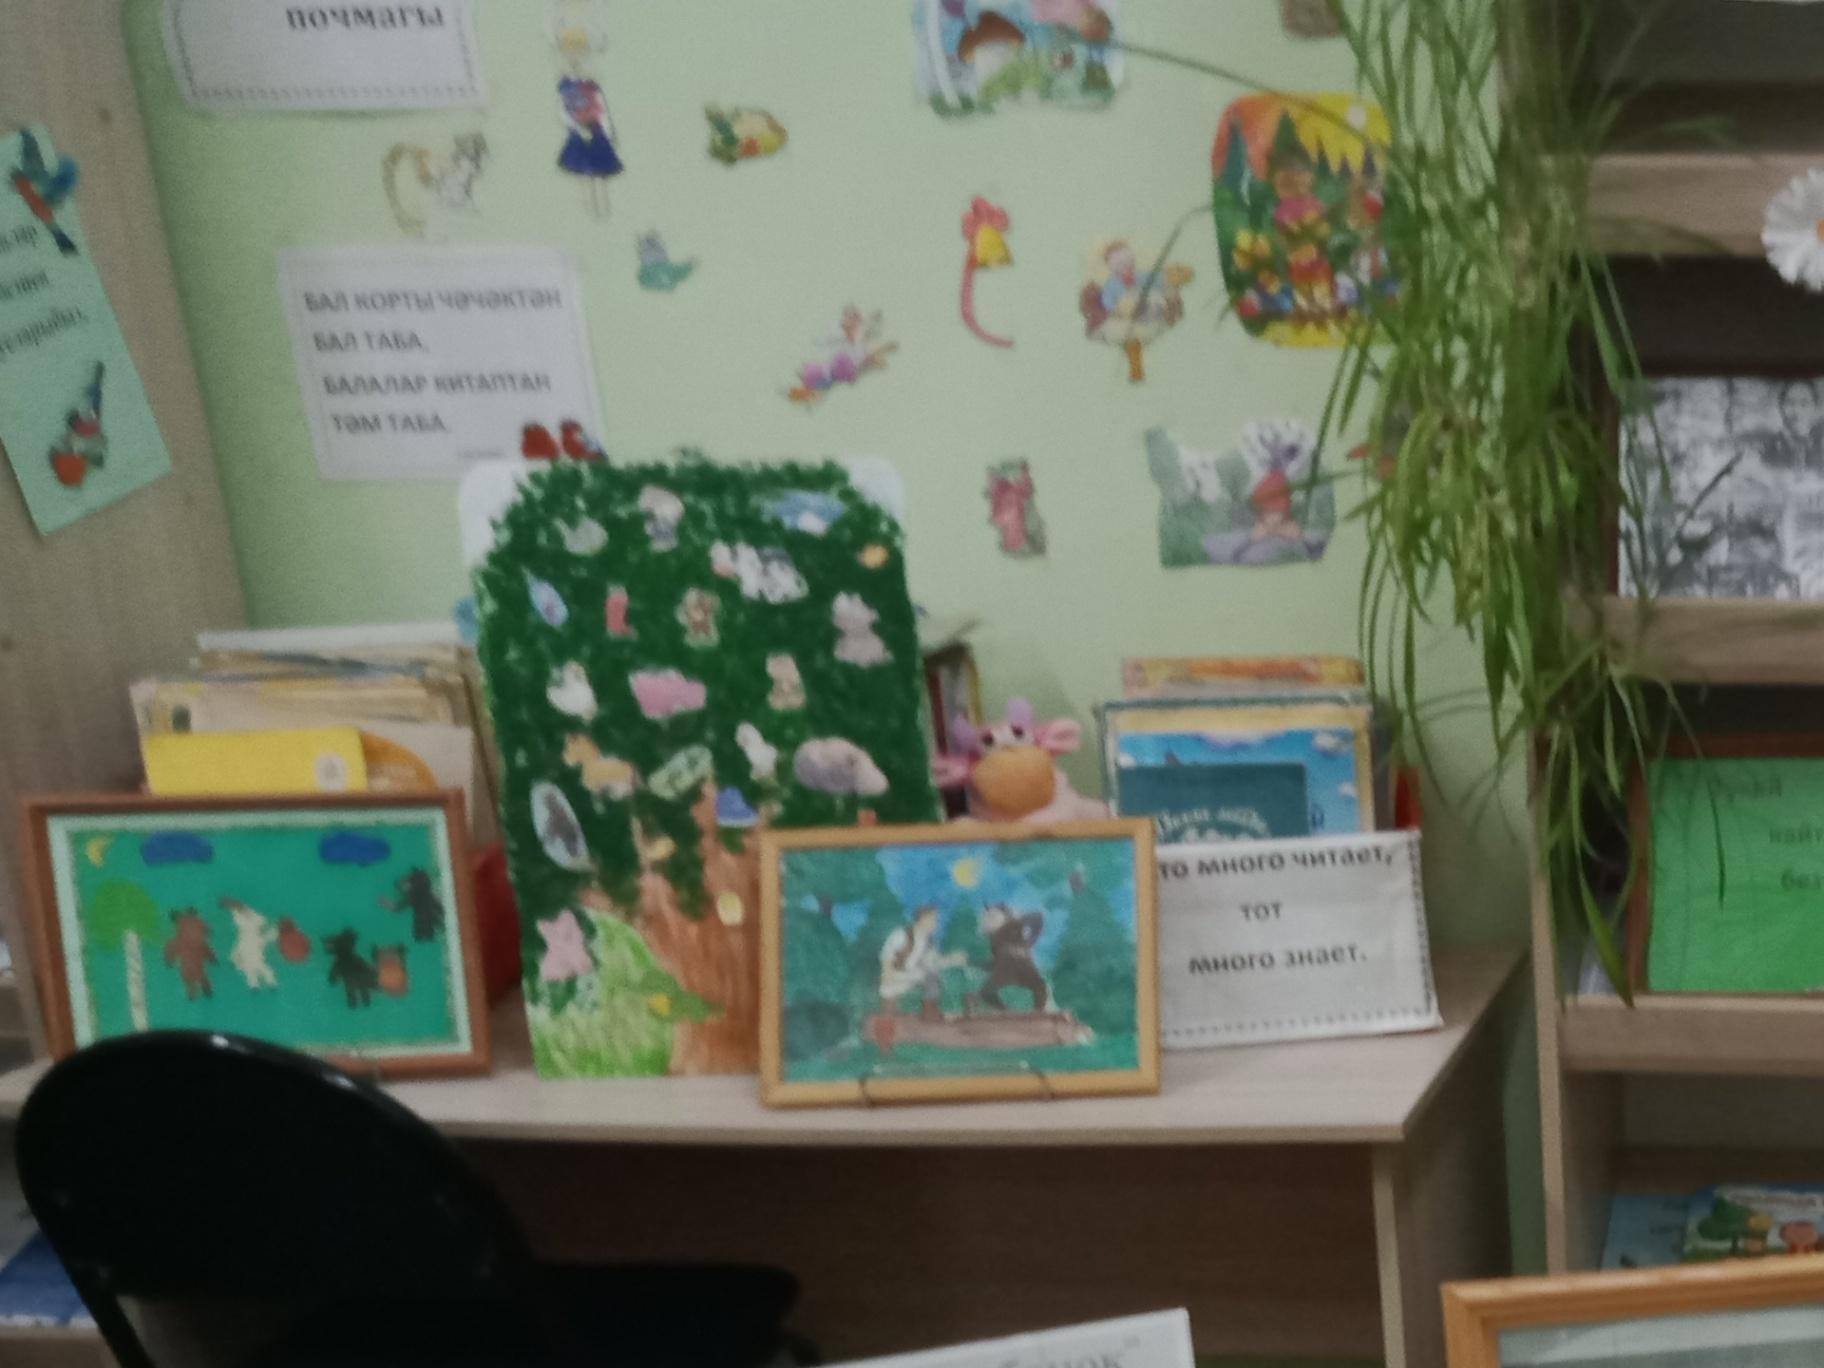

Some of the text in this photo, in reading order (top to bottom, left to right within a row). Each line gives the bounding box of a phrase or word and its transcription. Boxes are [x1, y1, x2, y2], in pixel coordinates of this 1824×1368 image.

[286, 7, 444, 29] почмагы
[304, 291, 349, 312] БАЛ
[354, 290, 435, 312] КОРТЫ
[1158, 846, 1393, 881] то много читает,
[1239, 902, 1283, 922] тот
[1188, 951, 1276, 976] много
